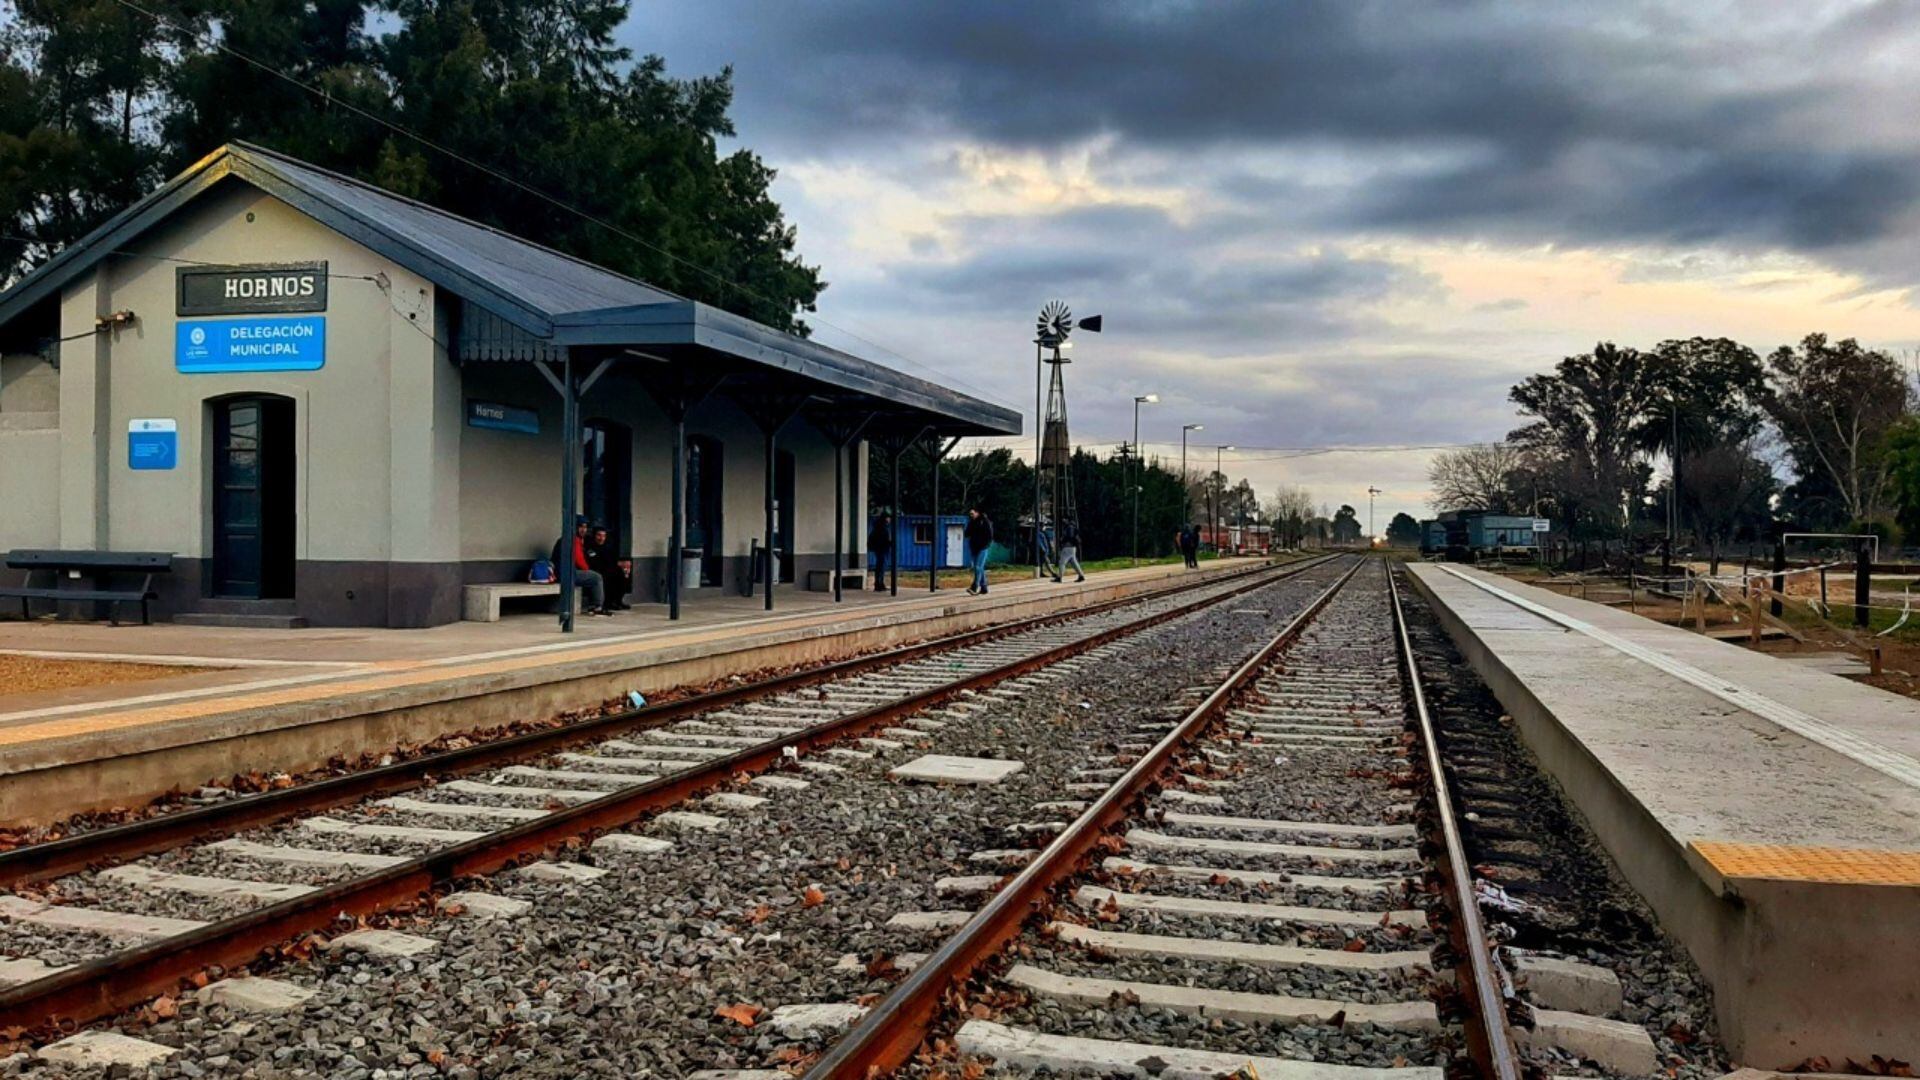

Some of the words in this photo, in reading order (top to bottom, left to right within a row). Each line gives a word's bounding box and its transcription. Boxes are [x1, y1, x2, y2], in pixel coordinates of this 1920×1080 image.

[225, 276, 314, 298] HORNOS
[230, 322, 313, 339] DELEGACIÓN
[230, 343, 299, 356] MUNICIPAL
[476, 404, 504, 420] Hornos
